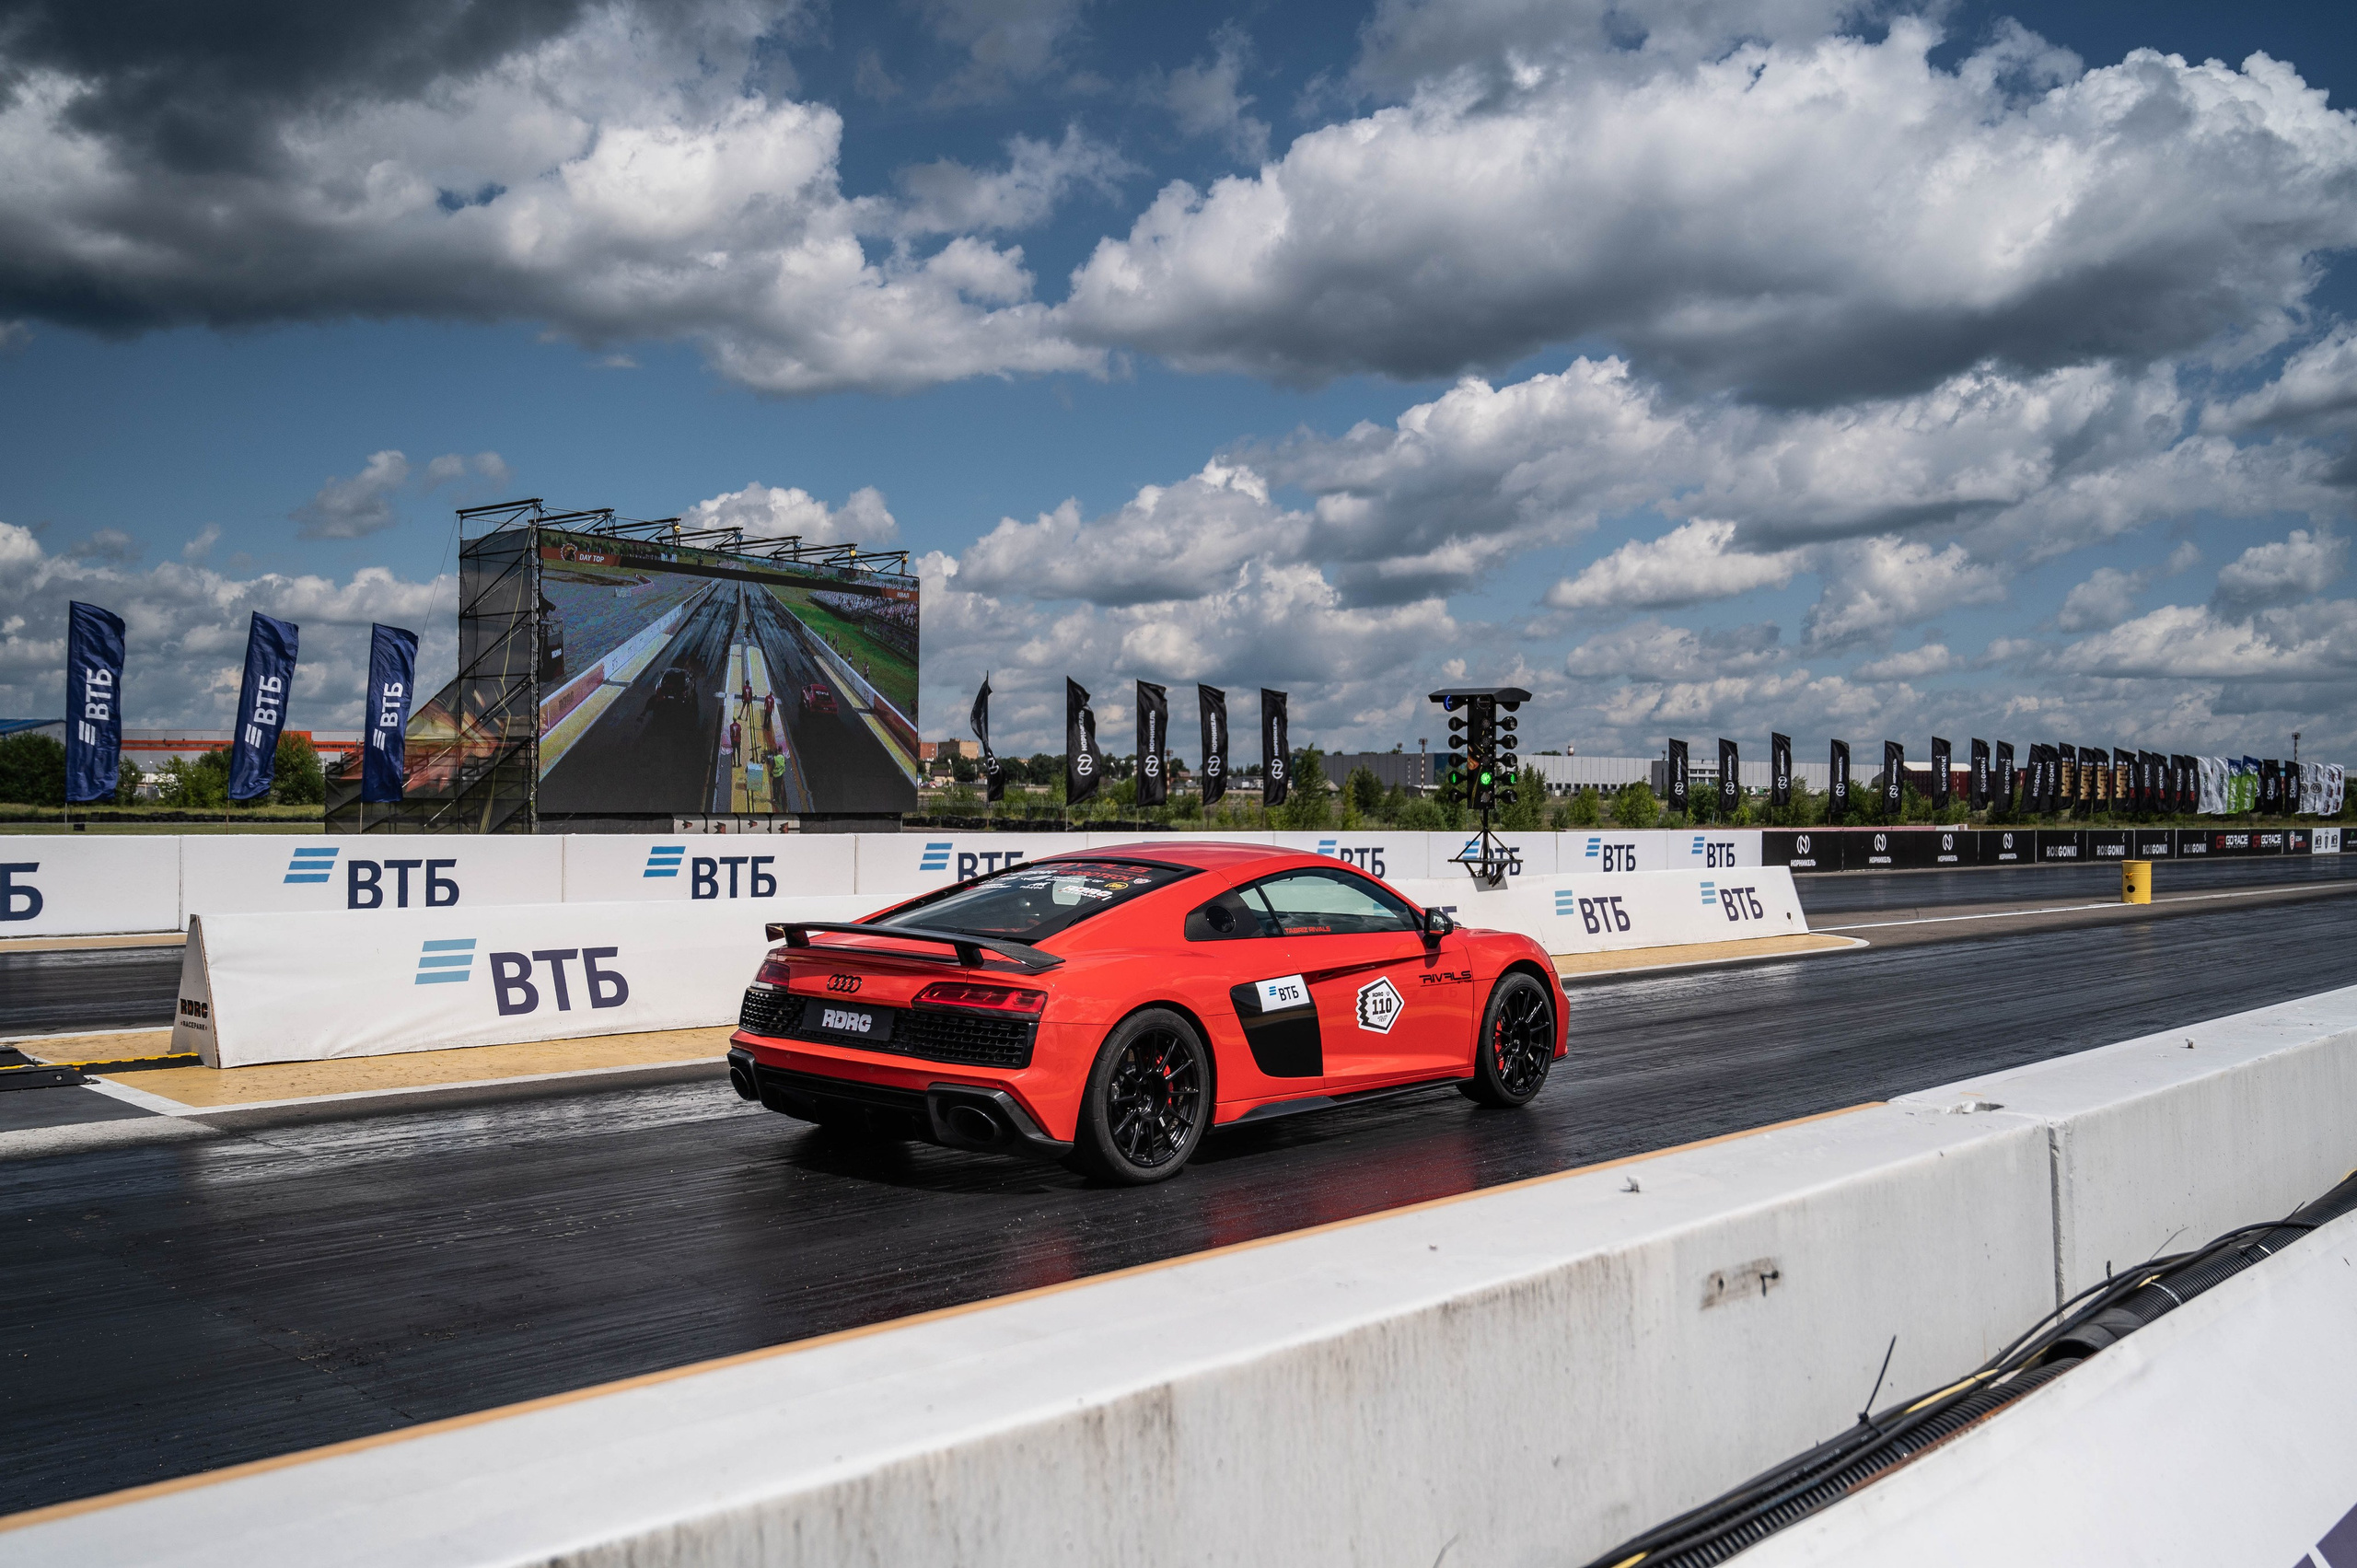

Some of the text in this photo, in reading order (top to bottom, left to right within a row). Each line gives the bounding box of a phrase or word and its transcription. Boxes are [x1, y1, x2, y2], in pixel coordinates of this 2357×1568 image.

[593, 554, 605, 563] TOP
[86, 668, 111, 721] ВТБ
[253, 675, 282, 726] ВТБ
[379, 682, 403, 727] ВТБ
[1603, 844, 1636, 872] ВТБ
[1707, 842, 1735, 867] ВТБ
[2047, 845, 2077, 857] ROSGONKI
[2096, 844, 2125, 856] ROSGONKI
[2142, 843, 2167, 855] ROSGONKI
[2184, 842, 2206, 854] ROSGONKI
[348, 859, 460, 910] ВТБ
[691, 855, 777, 900] ВТБ
[1578, 896, 1631, 935] ВТБ
[1720, 887, 1763, 921] ВТБ
[489, 947, 630, 1016] ВТБ
[1419, 970, 1471, 983] RIVALS
[1279, 985, 1299, 1001] ВТБ
[180, 998, 208, 1018] RDRC
[1372, 997, 1392, 1015] 110
[822, 1009, 872, 1032] RDRC
